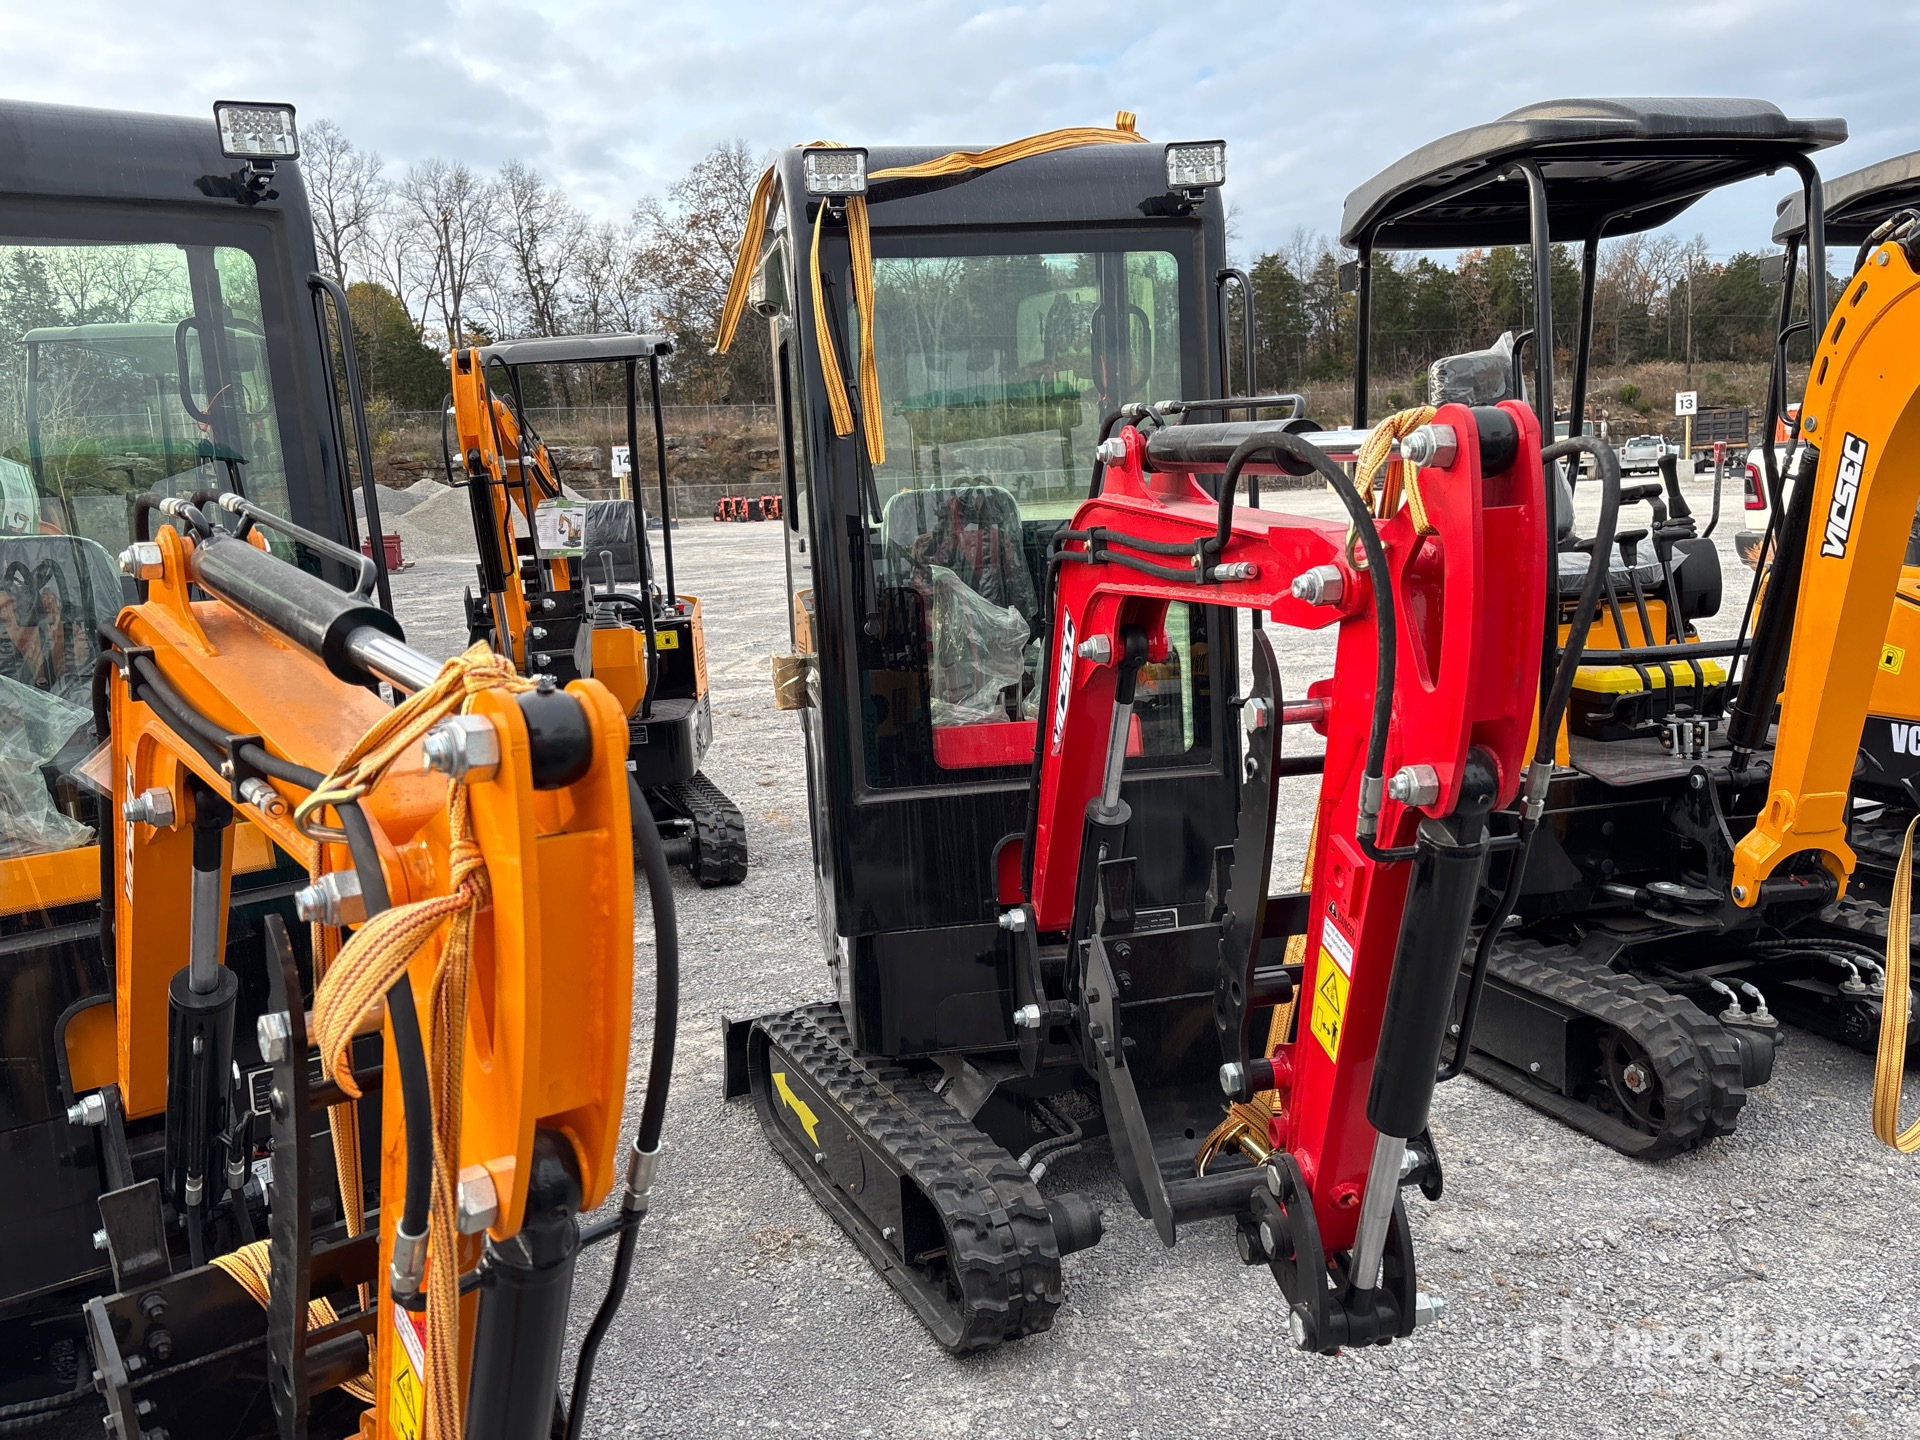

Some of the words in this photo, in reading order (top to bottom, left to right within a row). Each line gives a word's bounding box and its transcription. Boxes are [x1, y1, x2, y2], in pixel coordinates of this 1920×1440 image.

[1680, 399, 1693, 409] 13
[616, 454, 630, 466] 14
[1821, 432, 1868, 558] VICSEC
